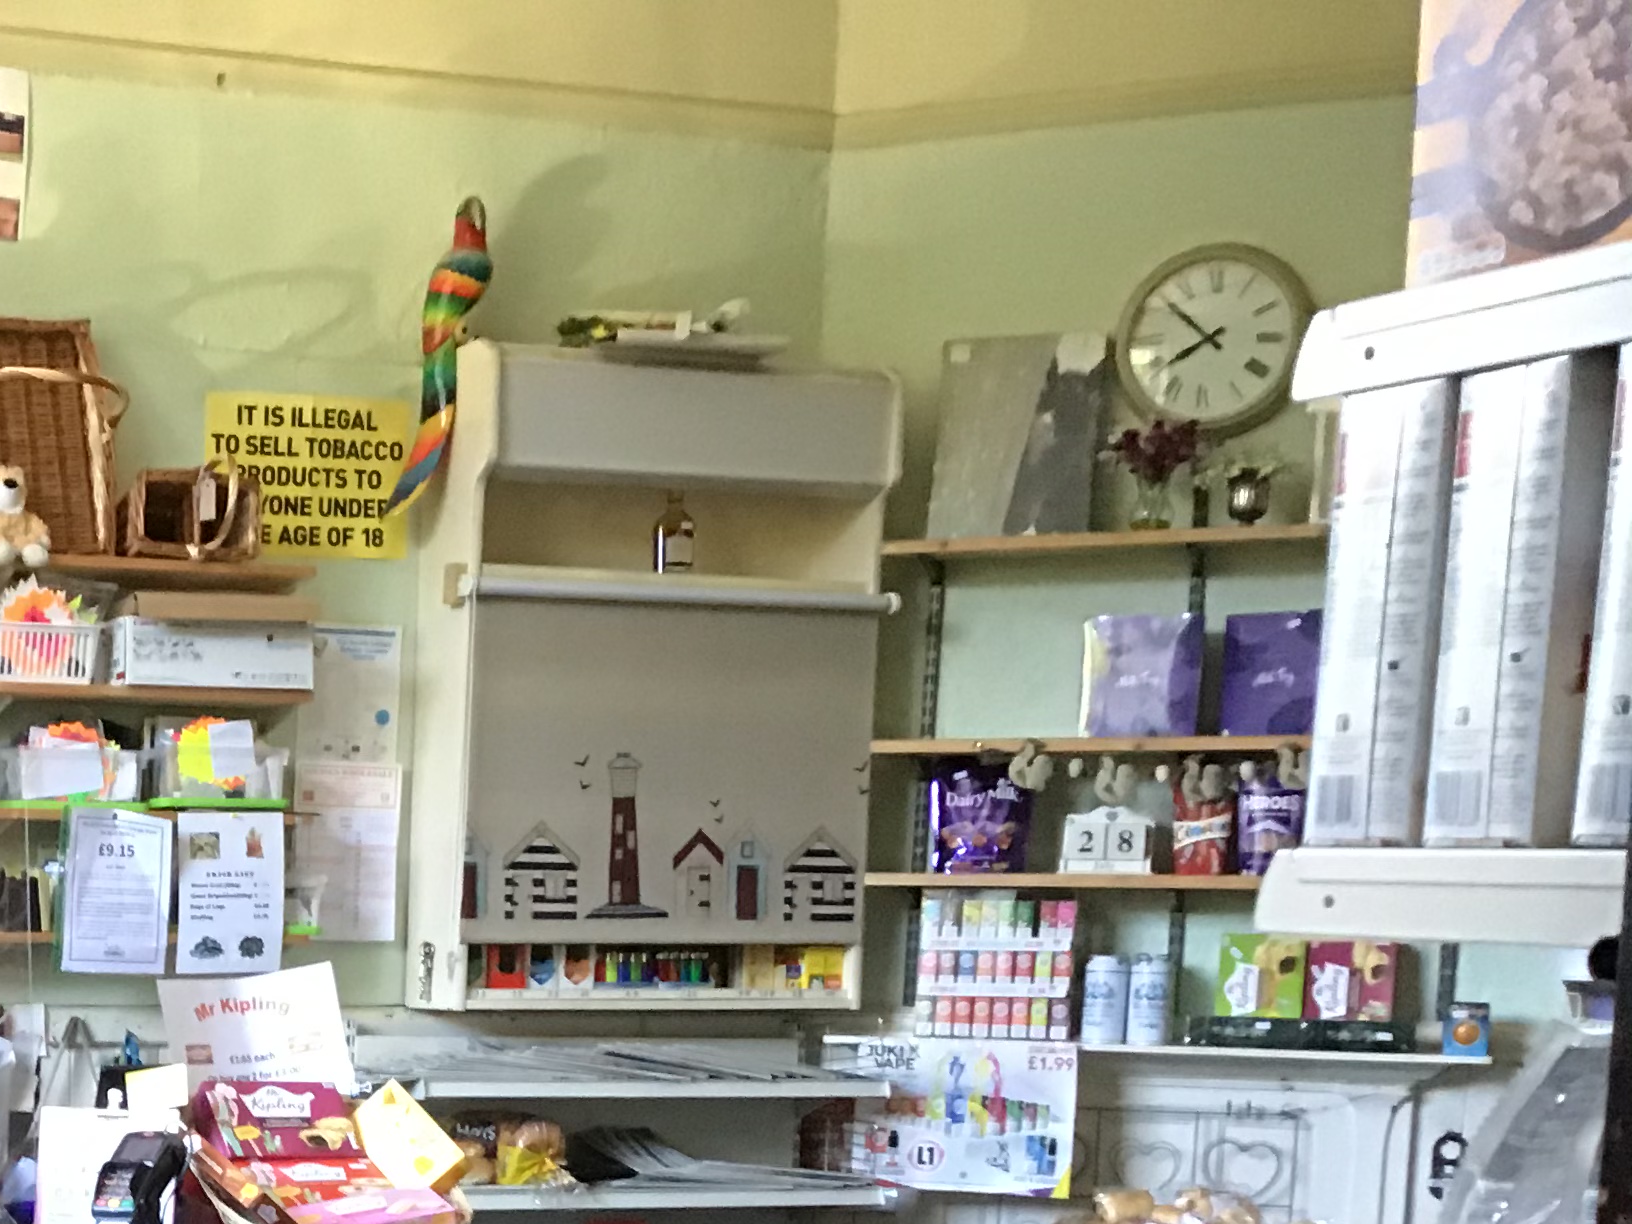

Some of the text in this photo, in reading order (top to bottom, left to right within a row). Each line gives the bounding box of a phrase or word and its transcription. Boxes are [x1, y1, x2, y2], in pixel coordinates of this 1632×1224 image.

[237, 404, 378, 431] IT IS ILLEGAL
[211, 433, 404, 461] TO SELL TOBACCO
[354, 469, 382, 490] TO
[278, 525, 321, 546] AGE
[327, 527, 355, 546] OF
[361, 528, 385, 547] 18
[945, 791, 986, 808] Dairy
[98, 843, 136, 858] £9.15
[1078, 830, 1095, 853] 2
[1116, 829, 1135, 853] 8
[194, 996, 291, 1022] Mr Kipling
[1027, 1056, 1075, 1072] £1.99
[250, 1097, 306, 1113] Kipling
[916, 1146, 935, 1165] L1
